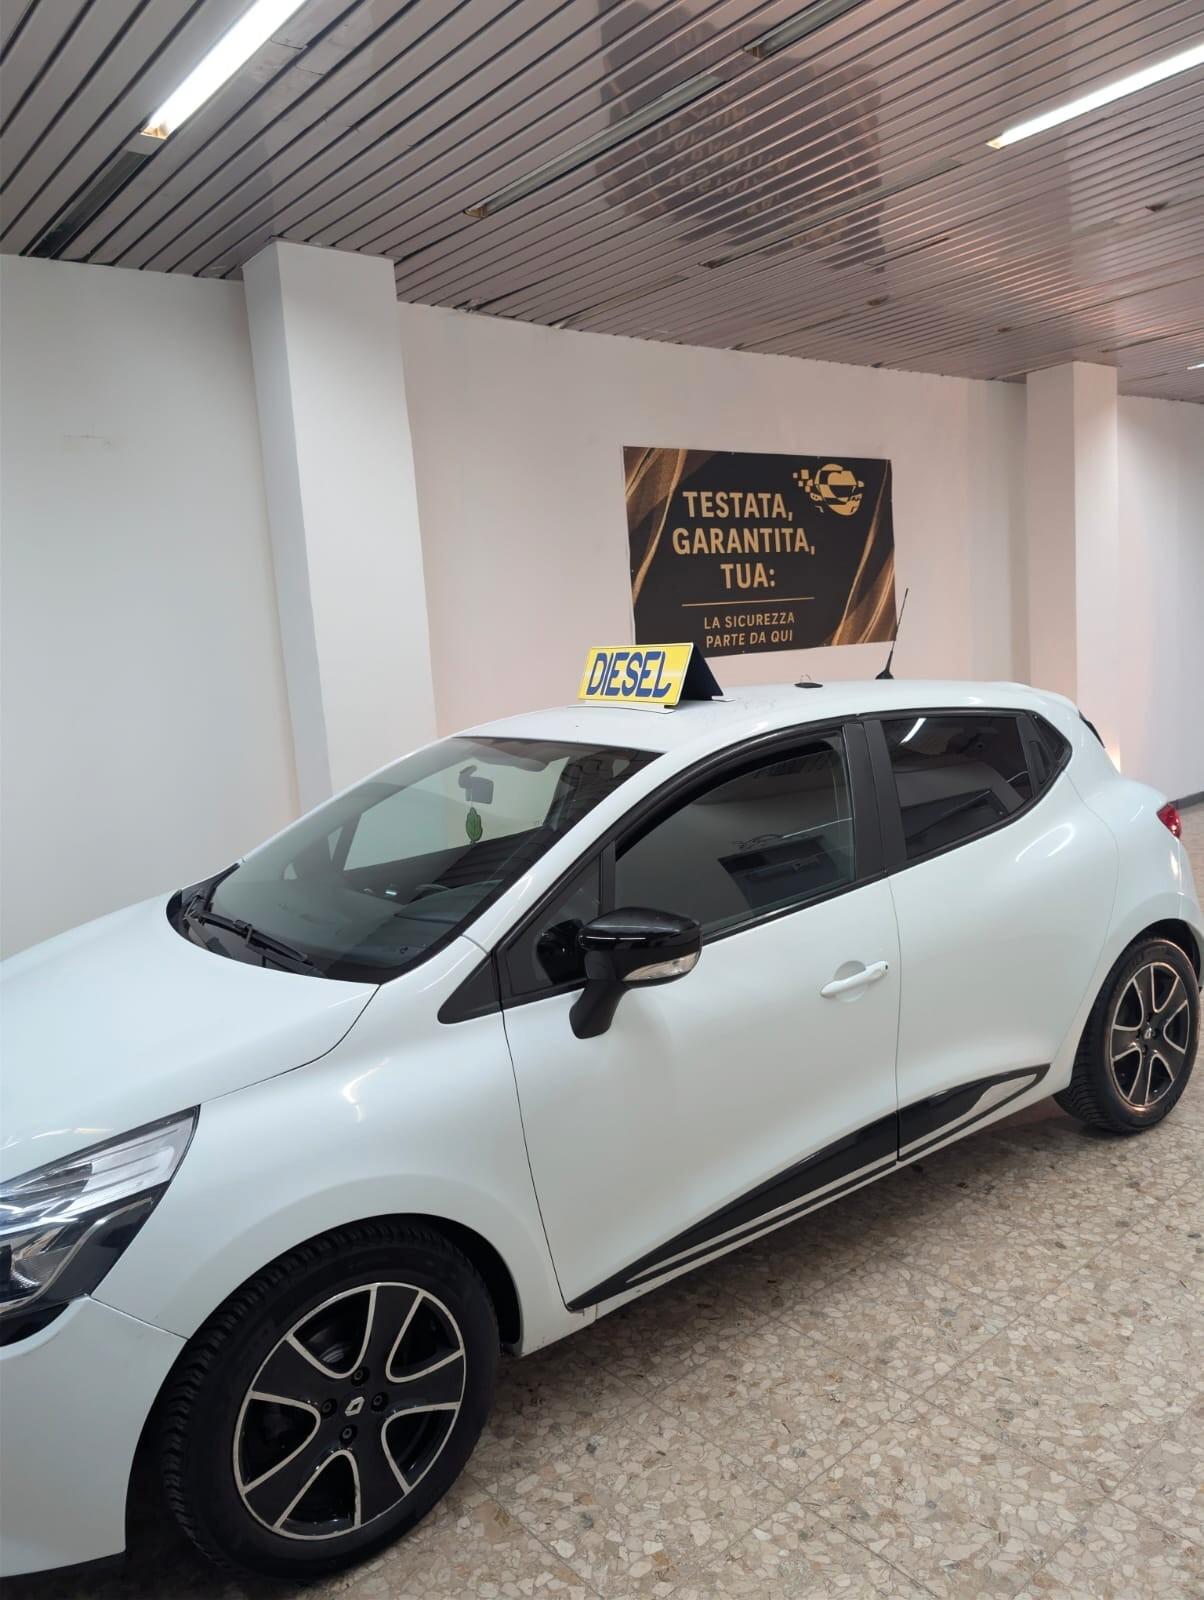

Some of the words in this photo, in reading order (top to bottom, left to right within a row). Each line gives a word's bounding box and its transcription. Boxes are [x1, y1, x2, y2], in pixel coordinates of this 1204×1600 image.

[682, 491, 793, 521] TESTATA,
[672, 527, 815, 555] GARANTITA,
[720, 563, 776, 589] TUA:
[704, 616, 720, 630] LA
[724, 612, 795, 628] SICUREZZA
[706, 632, 745, 648] PARTE
[750, 631, 766, 644] DA
[770, 629, 793, 643] QUI
[586, 651, 672, 698] DIESEL
